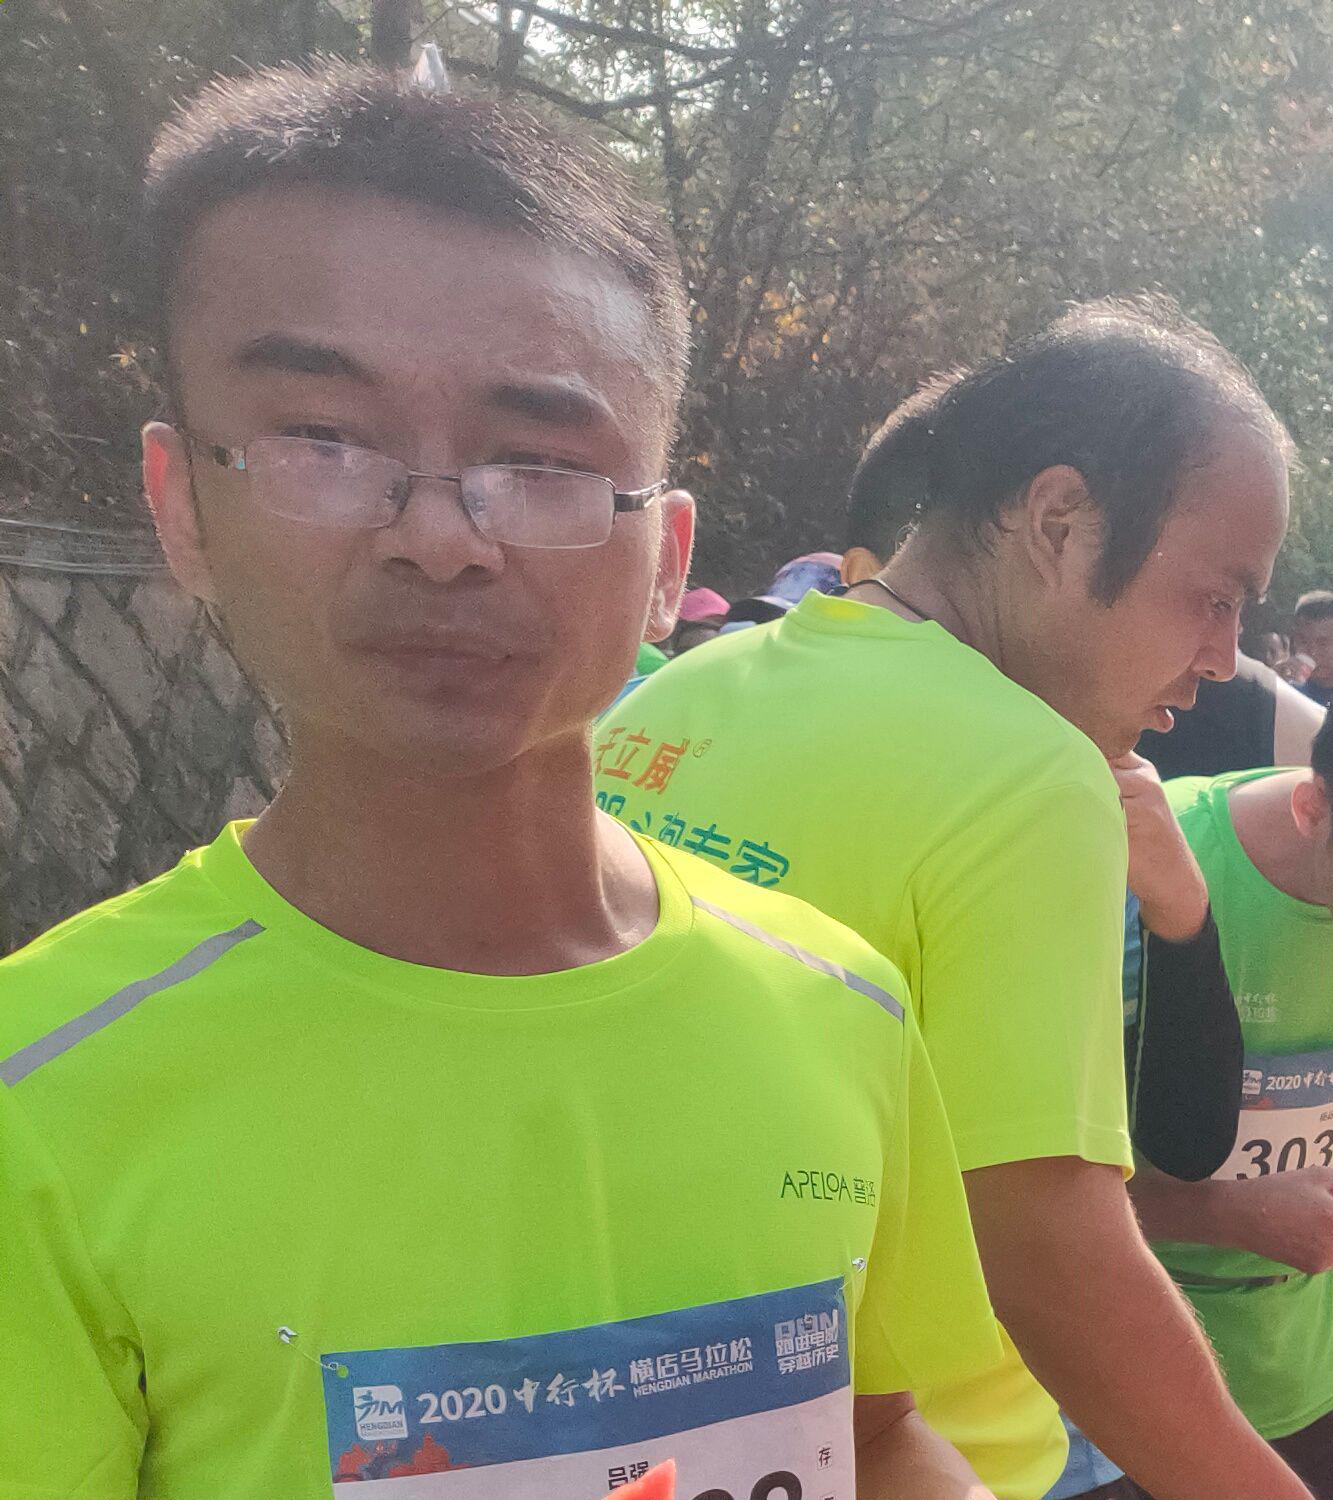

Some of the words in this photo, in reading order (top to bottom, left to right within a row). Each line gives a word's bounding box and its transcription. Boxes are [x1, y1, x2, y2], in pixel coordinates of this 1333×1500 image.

[1265, 1074, 1301, 1092] 2020
[781, 1170, 853, 1202] APELOA
[416, 1383, 508, 1424] 2020
[513, 1366, 626, 1413] 中行杯
[629, 1337, 754, 1385] 横店马拉松
[633, 1373, 691, 1399] HENGDIAN
[691, 1360, 754, 1385] MARATHON
